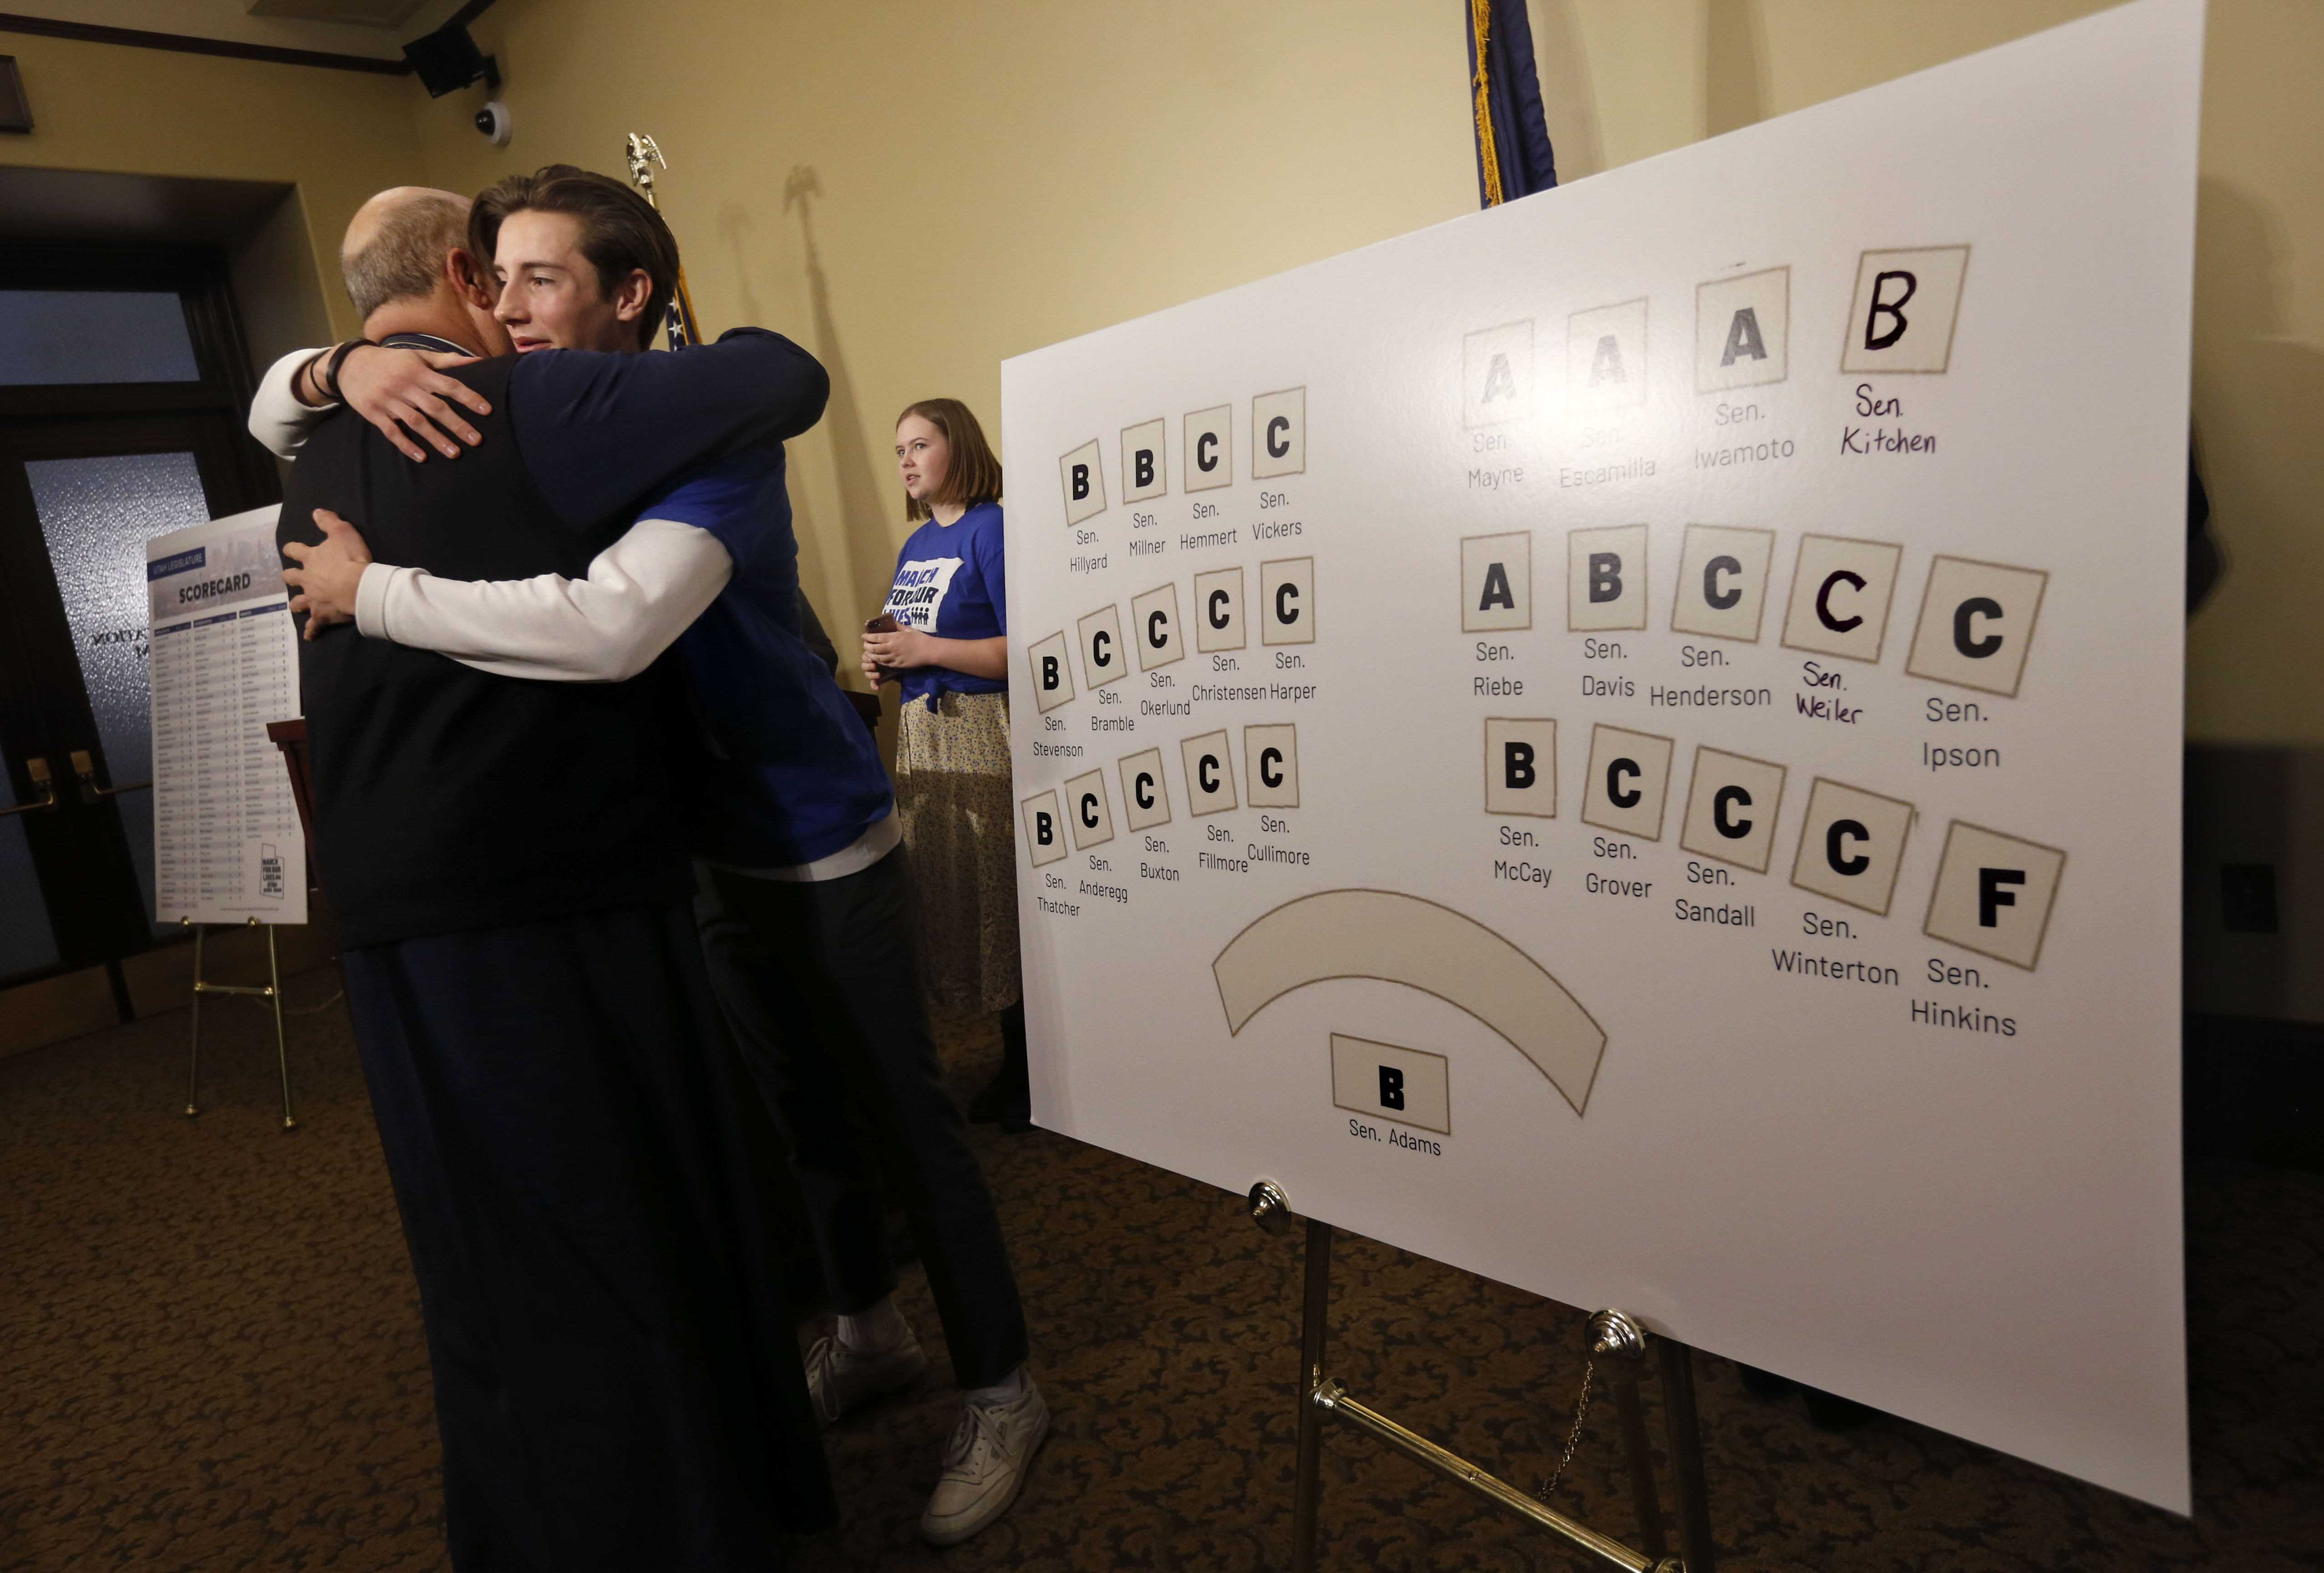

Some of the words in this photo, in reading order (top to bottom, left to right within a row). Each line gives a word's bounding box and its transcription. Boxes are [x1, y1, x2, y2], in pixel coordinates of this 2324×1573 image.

[1864, 270, 1917, 351] B
[1720, 306, 1768, 367] A
[1587, 333, 1628, 388] A
[1480, 352, 1516, 404] A
[1855, 383, 1904, 418] Sen.
[1715, 403, 1766, 426] Sen.
[1267, 416, 1290, 458] C
[1841, 426, 1936, 455] Kitchen
[1197, 432, 1218, 472] C
[1694, 439, 1795, 469] Iwamoto
[1135, 449, 1154, 488] B
[1468, 467, 1524, 490] Mayne
[1560, 457, 1656, 488] Escamilla
[1072, 464, 1090, 501] B
[1193, 502, 1219, 519] Sen.
[1260, 492, 1289, 509] Sen.
[1133, 512, 1157, 529] Sen.
[1252, 521, 1302, 540] Vickers
[1077, 530, 1099, 545] Sen.
[1130, 539, 1166, 557] Millner
[1180, 528, 1237, 550] Hemmert
[153, 564, 167, 575] UTAH
[167, 553, 203, 571] LEGISLATURE
[1070, 553, 1107, 574] Hillyard
[179, 573, 251, 604] SCORECARD
[1479, 563, 1515, 611] A
[1589, 553, 1623, 604] B
[1704, 555, 1742, 610] C
[1208, 589, 1230, 629] C
[1276, 583, 1299, 625] C
[1816, 570, 1867, 633] C
[1148, 610, 1168, 649] C
[1953, 597, 2004, 659] C
[1093, 630, 1111, 667] C
[1276, 652, 1305, 669] Sen.
[1476, 642, 1514, 661] Sen.
[1584, 638, 1627, 659] Sen.
[1682, 645, 1729, 667] Sen.
[1042, 656, 1059, 690] B
[1213, 655, 1239, 672] Sen.
[1803, 661, 1847, 690] Sen.
[1151, 672, 1175, 688] Sen.
[1192, 685, 1267, 701] Christensen
[1270, 683, 1316, 703] Harper
[1474, 677, 1523, 696] Riebe
[1583, 675, 1634, 697] Davis
[1099, 689, 1121, 705] Sen.
[1141, 700, 1190, 715] Okerlund
[1651, 685, 1771, 706] Henderson
[1796, 693, 1863, 725] Weiler
[1926, 697, 1988, 722] Sen.
[1045, 716, 1066, 731] Sen.
[1091, 716, 1134, 731] Bramble
[1033, 741, 1083, 757] Stevenson
[1924, 742, 1999, 772] Ipson
[1199, 754, 1220, 793] C
[1260, 747, 1283, 788] C
[1505, 741, 1536, 789] B
[1135, 772, 1154, 809] C
[1607, 757, 1641, 809] C
[1081, 792, 1099, 828] C
[1714, 785, 1752, 839] C
[1036, 812, 1053, 846] B
[1207, 824, 1234, 842] Sen.
[1261, 815, 1289, 833] Sen.
[1500, 826, 1539, 847] Sen.
[1145, 836, 1169, 853] Sen.
[1246, 843, 1309, 867] Cullimore
[1593, 837, 1637, 859] Sen.
[1826, 819, 1870, 876] C
[1089, 855, 1112, 872] Sen.
[1141, 862, 1179, 881] Buxton
[1199, 852, 1248, 873] Fillmore
[1495, 860, 1552, 888] McCay
[1687, 860, 1736, 886] Sen.
[1045, 873, 1066, 889] Sen.
[1079, 880, 1128, 903] Anderegg
[1586, 873, 1652, 898] Grover
[1037, 897, 1080, 916] Thatcher
[1979, 868, 2026, 928] F
[1675, 898, 1754, 927] Sandall
[1803, 912, 1857, 939] Sen.
[1771, 949, 1898, 986] Winterton
[1928, 959, 1989, 989] Sen.
[1912, 999, 2016, 1036] Hinkins
[1379, 1065, 1405, 1111] B
[1349, 1119, 1381, 1142] Sen.
[1389, 1129, 1441, 1156] Adams
